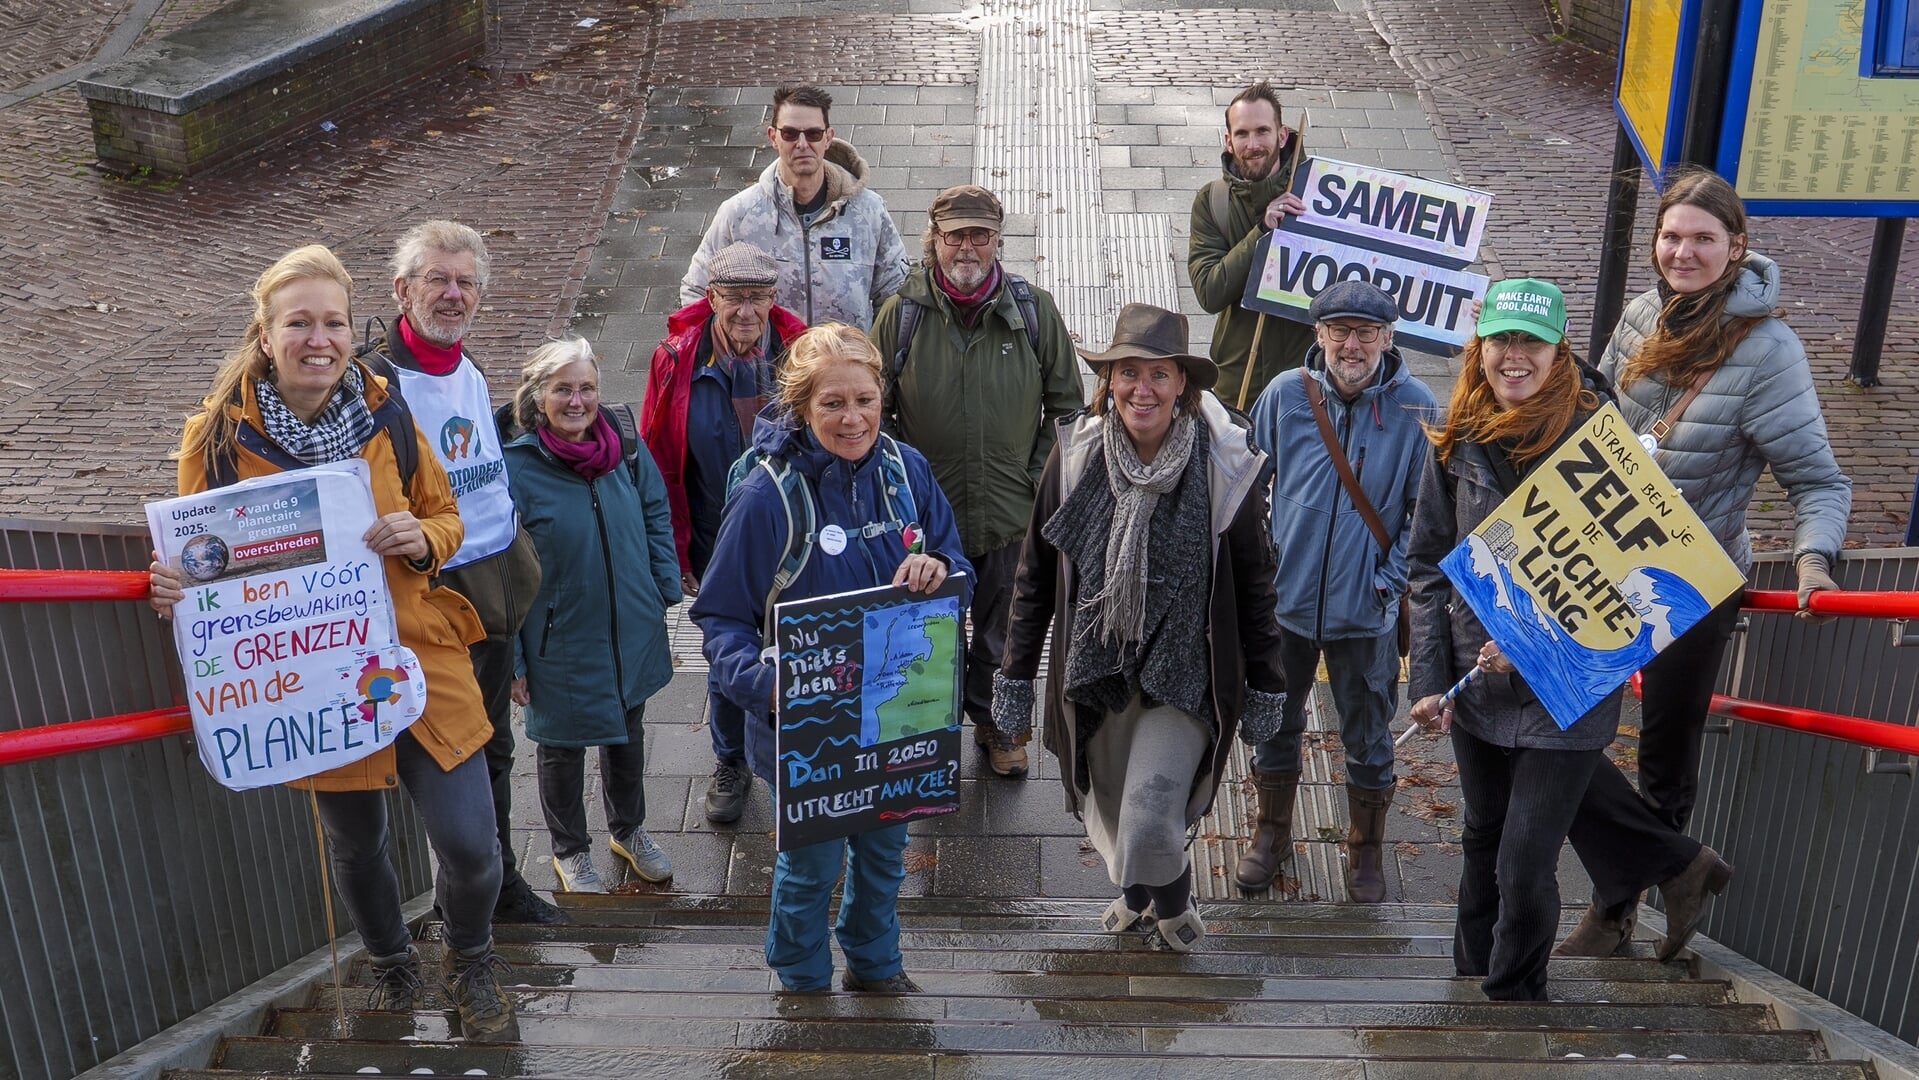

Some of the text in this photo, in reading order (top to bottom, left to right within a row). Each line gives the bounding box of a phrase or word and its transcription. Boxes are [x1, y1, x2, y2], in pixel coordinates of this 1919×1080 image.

[1312, 173, 1476, 247] SAMEN
[1496, 301, 1549, 317] COOL AGAIN
[1497, 291, 1553, 308] MAKE EARTH
[447, 458, 505, 488] OTOUDERS
[1593, 414, 1639, 476] STRAKS
[1640, 483, 1673, 518] BEN
[245, 503, 270, 514] van
[273, 499, 289, 510] de
[290, 496, 299, 507] 9
[1555, 438, 1670, 553] ZELF
[172, 504, 217, 522] Update
[238, 508, 301, 531] planetaire
[174, 523, 209, 538] 2025:
[247, 522, 297, 541] grenzen
[1581, 521, 1604, 546] DE
[235, 535, 319, 559] overschreden
[1521, 484, 1639, 640] VLUCHTE-
[197, 587, 221, 611] ik
[243, 579, 289, 604] ben
[194, 655, 225, 678] DE
[233, 617, 370, 671] GRENZEN
[264, 670, 304, 703] de
[213, 697, 387, 779] PLANEET
[788, 760, 841, 788] Dan
[887, 739, 938, 765] 2050
[787, 785, 880, 824] UTRECHT
[880, 777, 914, 800] AAN
